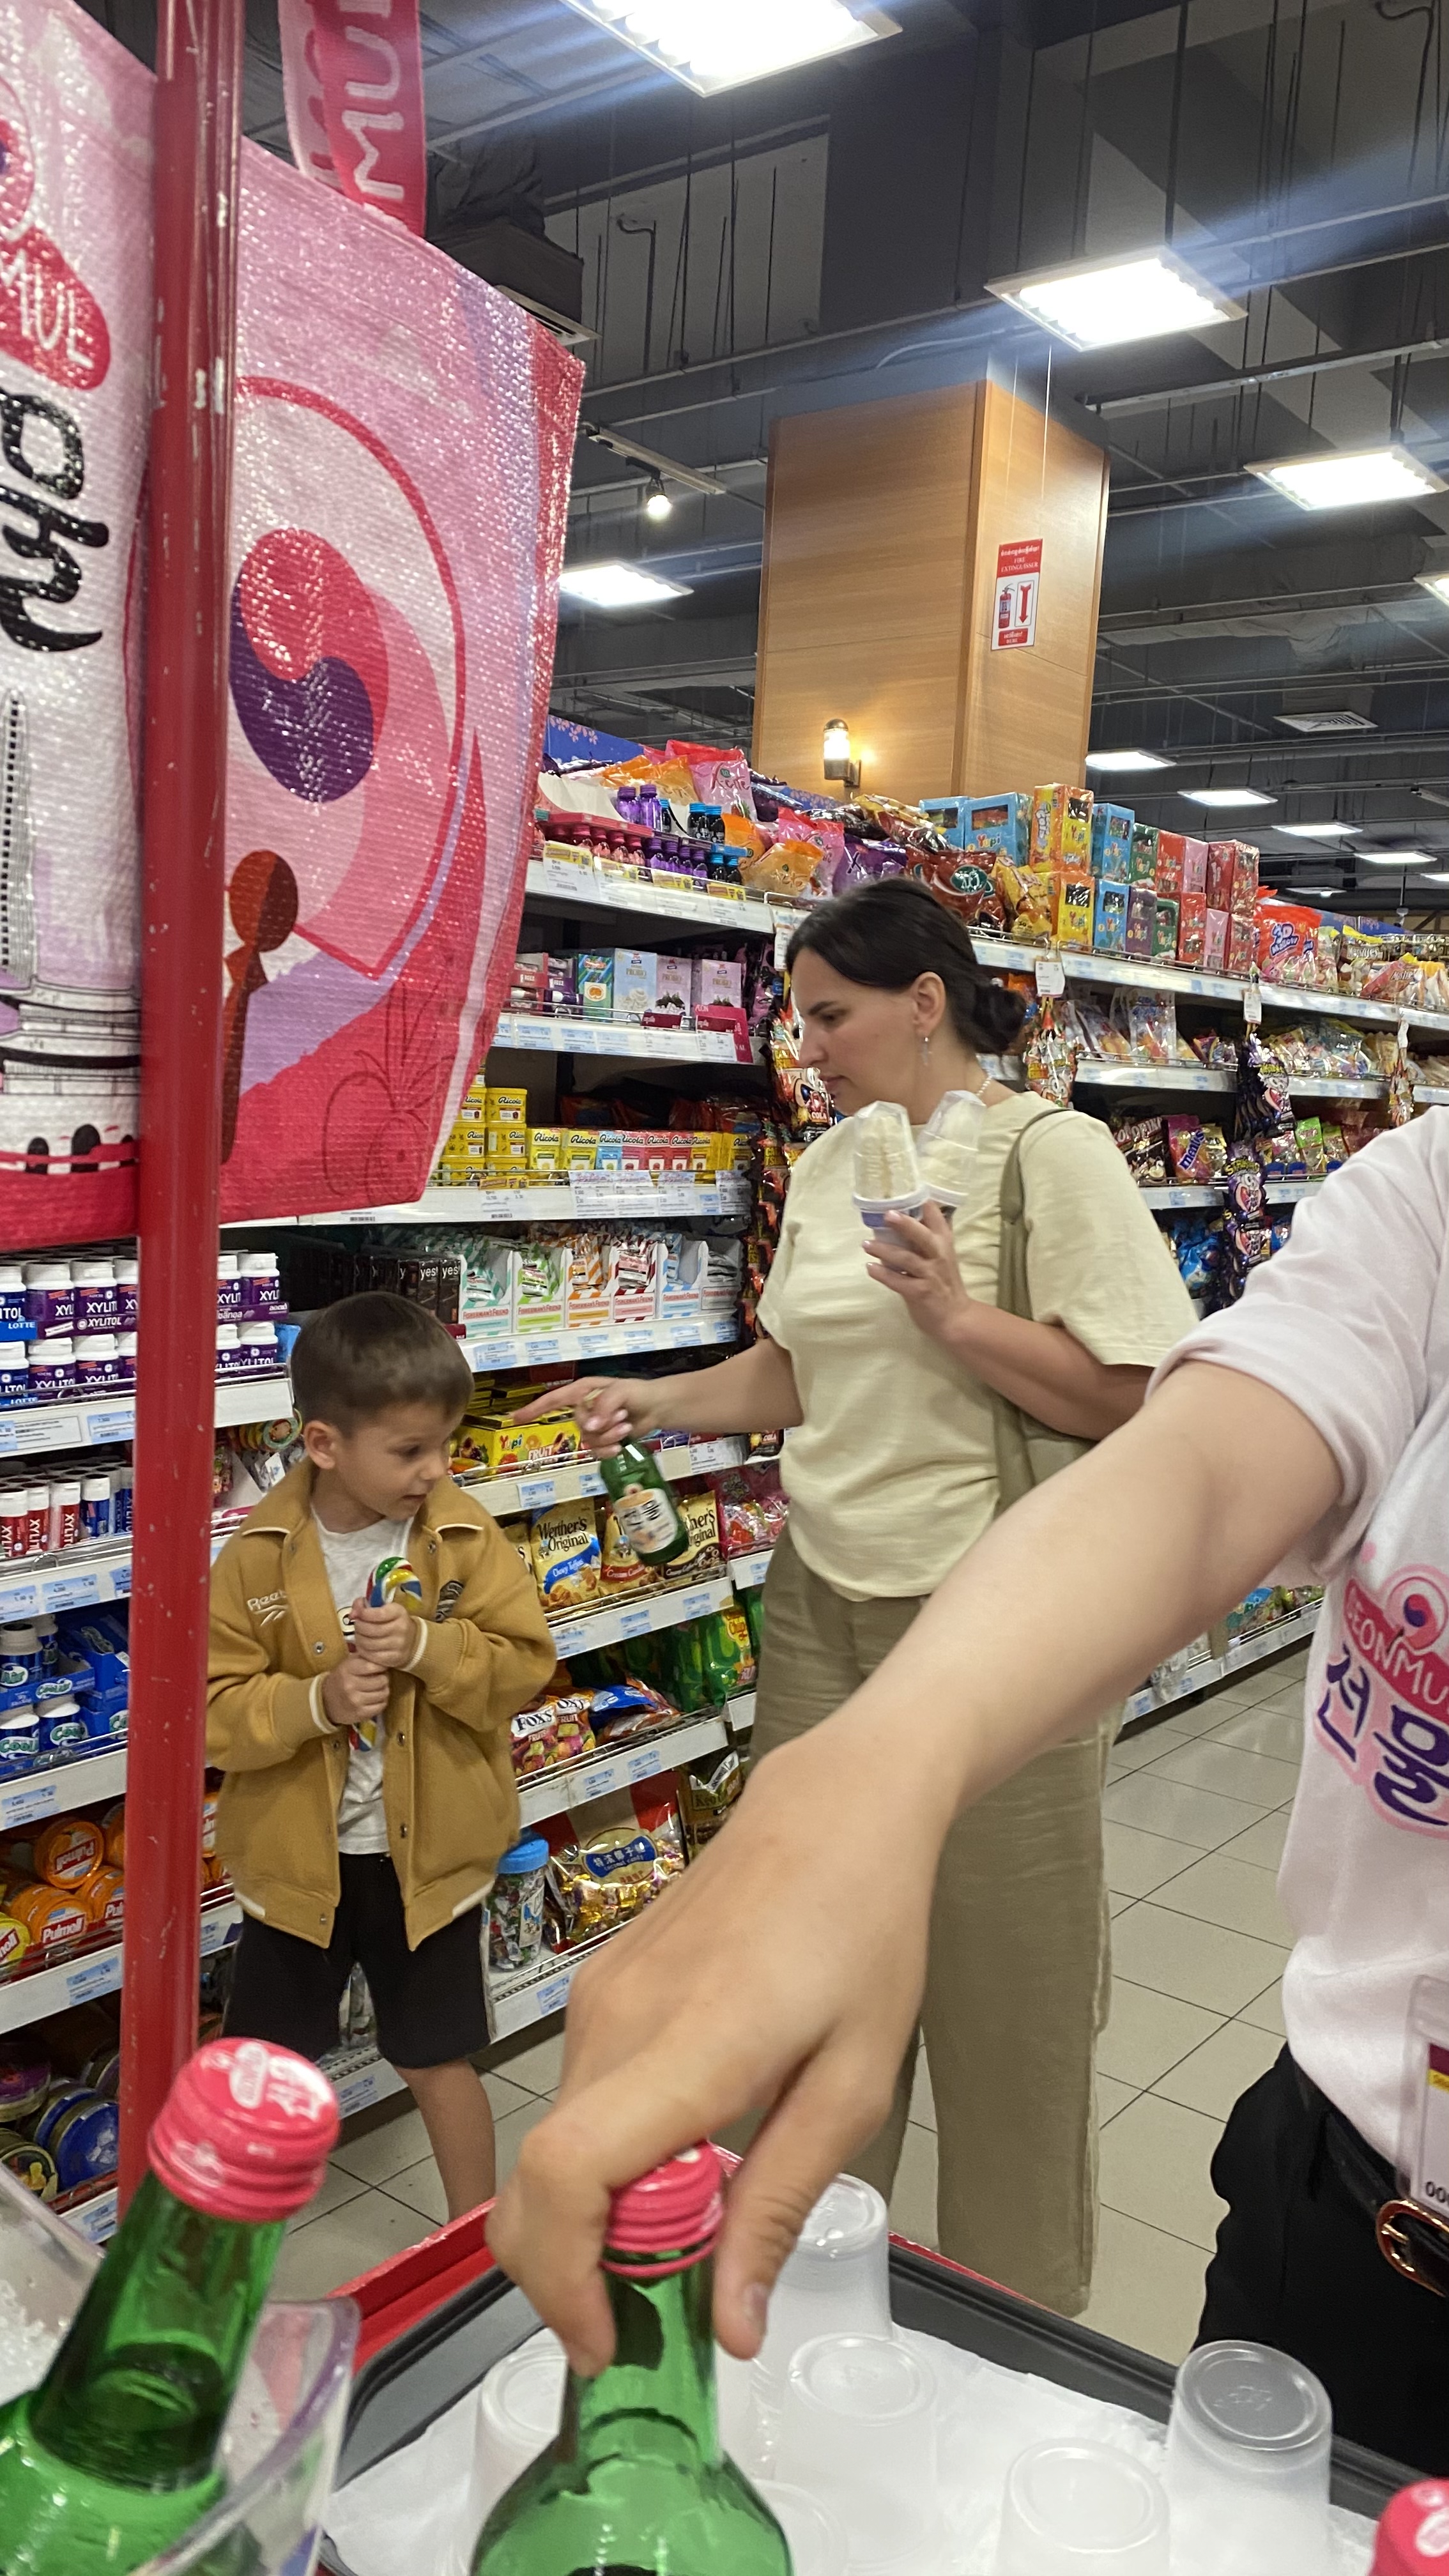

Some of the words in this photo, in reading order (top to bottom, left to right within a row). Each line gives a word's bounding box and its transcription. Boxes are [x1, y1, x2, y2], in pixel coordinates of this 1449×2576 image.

[976, 833, 1002, 848] Yupi
[498, 1096, 522, 1105] Ricola
[533, 1132, 559, 1142] Ricola
[571, 1135, 597, 1144] Ricola
[599, 1133, 621, 1144] Ricola
[647, 1135, 669, 1144] Ricola
[671, 1134, 693, 1144] Ricola
[1179, 1130, 1205, 1169] mentos
[420, 1266, 438, 1280] yes!
[442, 1264, 460, 1280] yes!
[8, 1321, 36, 1330] LOTTE
[88, 1317, 121, 1327] XYLITOL
[500, 1434, 523, 1450] Yupi
[528, 1444, 554, 1460] FRUIT
[537, 1516, 588, 1540] Werther's
[549, 1532, 590, 1552] Original
[42, 1916, 84, 1943] Pulmoll
